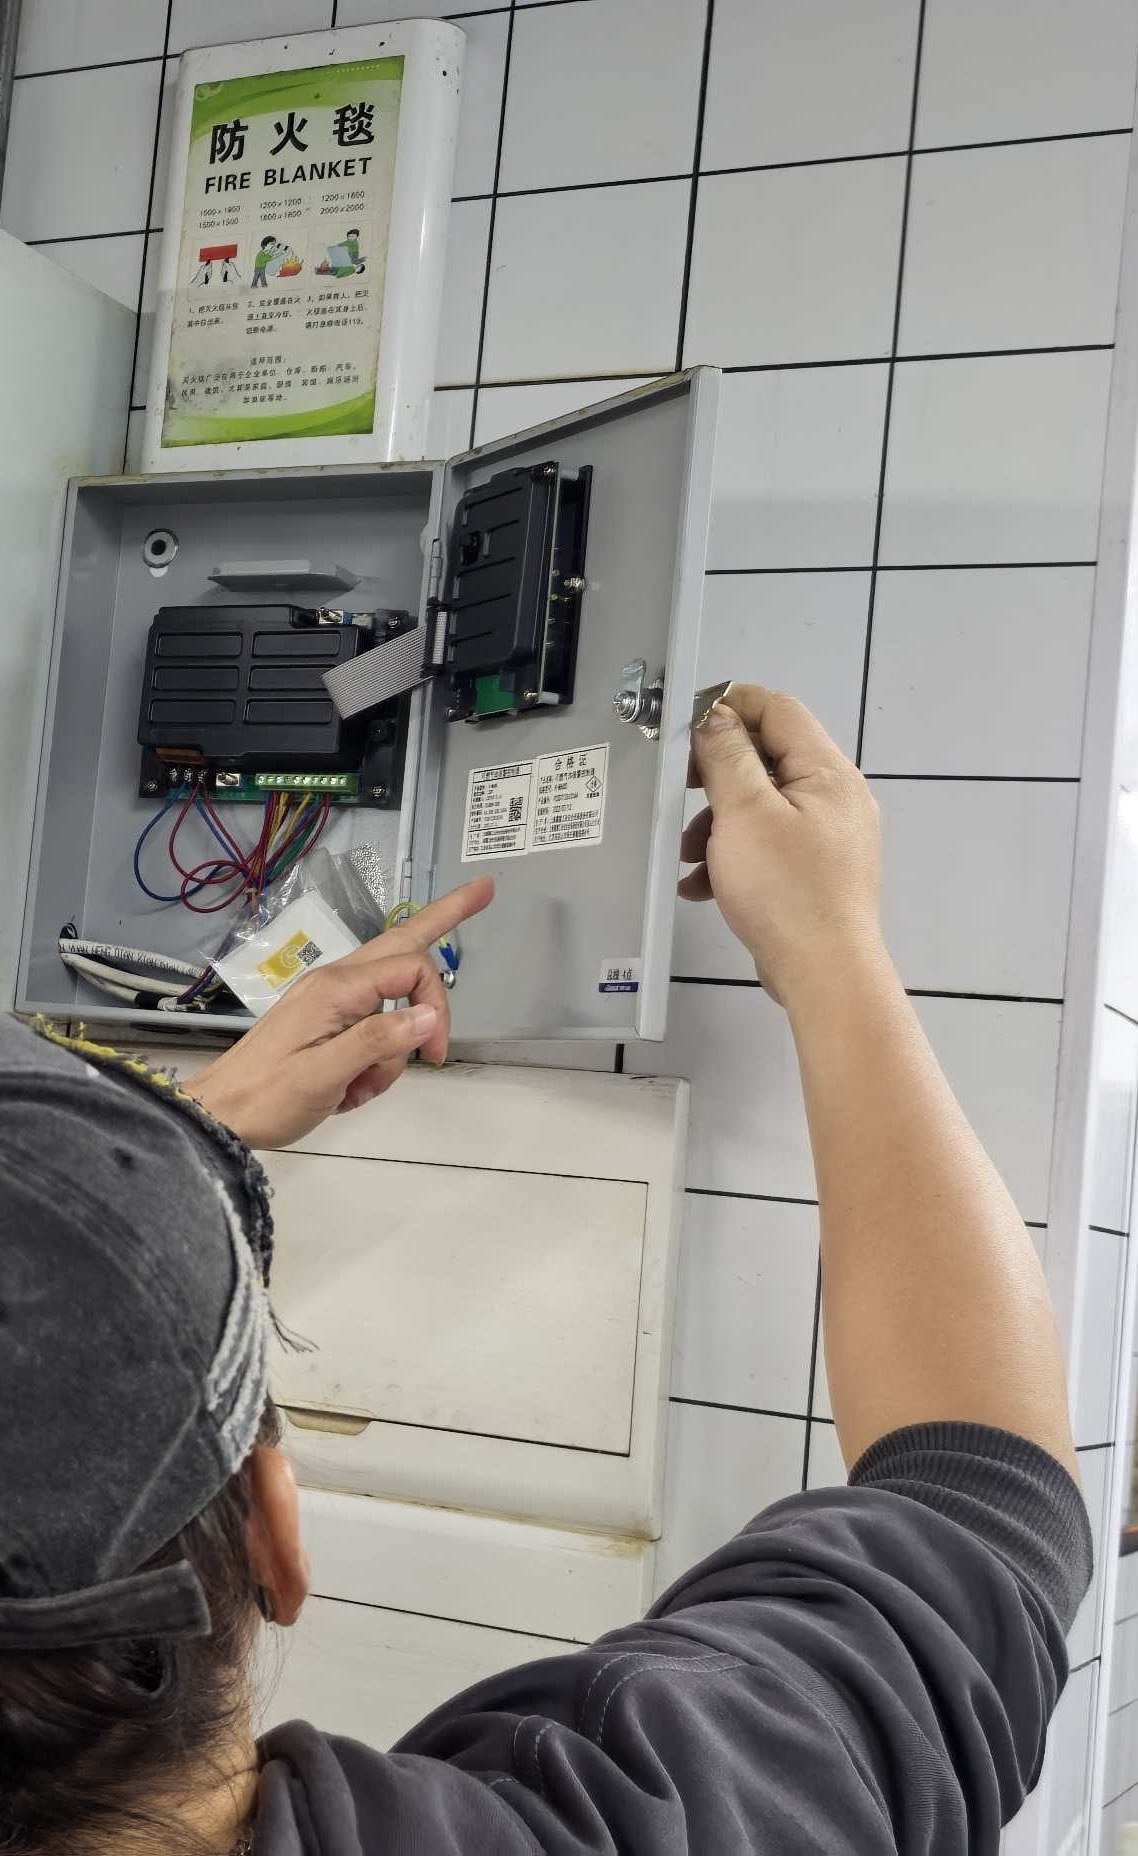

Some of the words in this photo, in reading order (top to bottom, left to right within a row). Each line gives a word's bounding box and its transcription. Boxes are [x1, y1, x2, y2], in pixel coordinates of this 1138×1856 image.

[209, 102, 375, 164] 防火毯
[204, 171, 251, 194] FIRE
[263, 157, 372, 186] BLANKET
